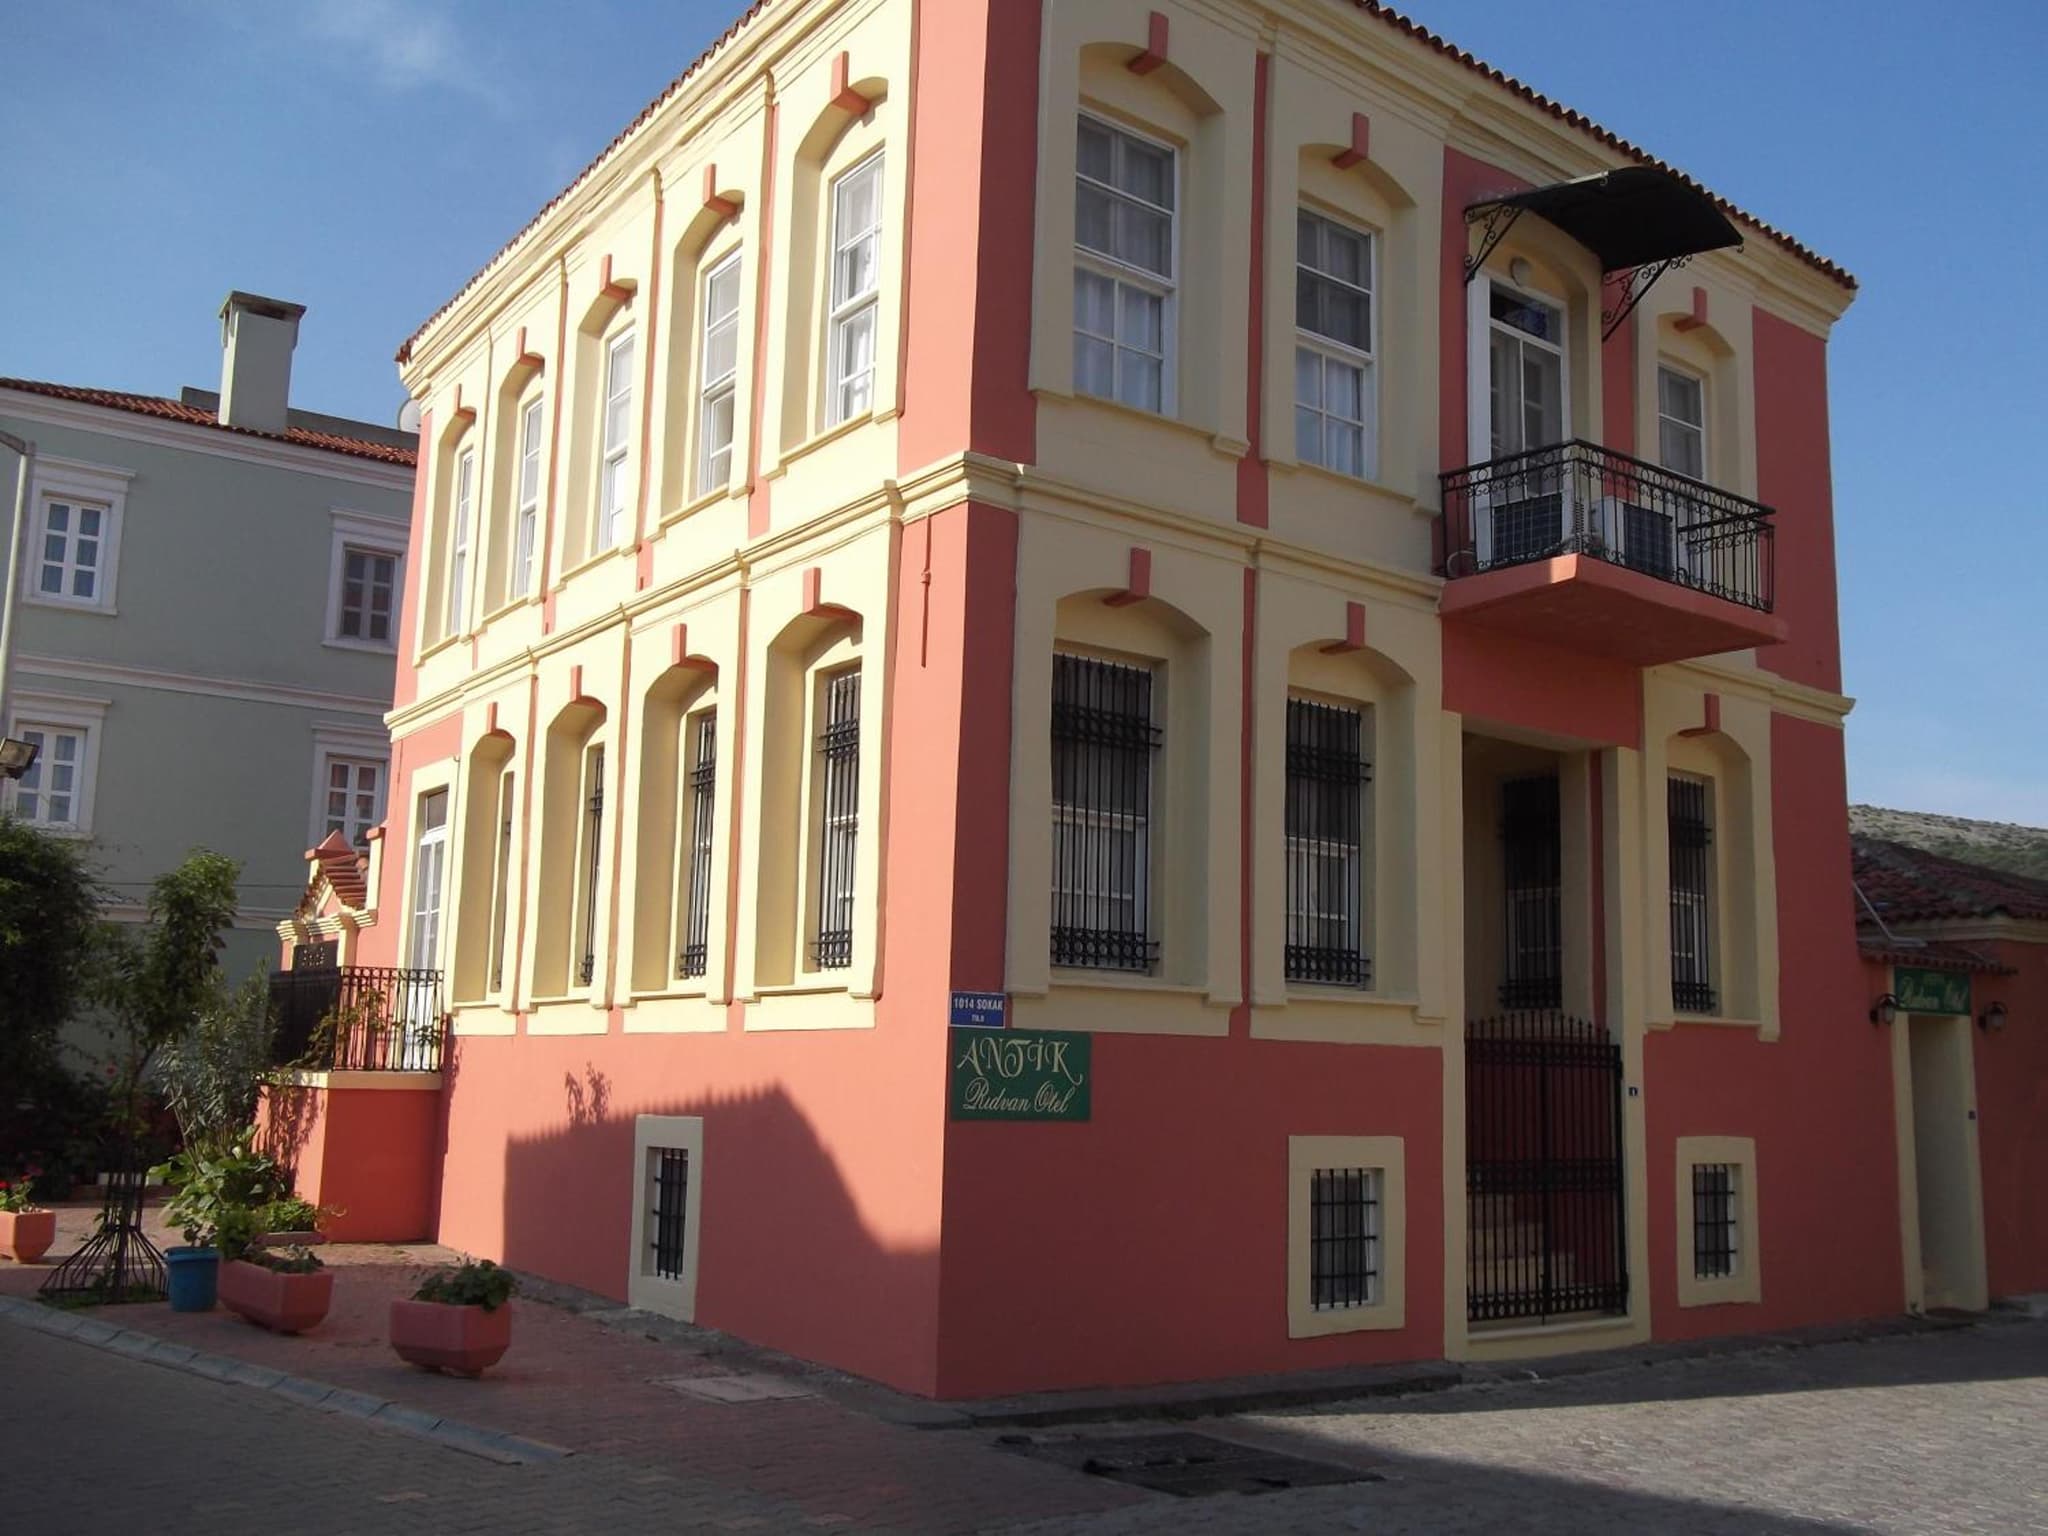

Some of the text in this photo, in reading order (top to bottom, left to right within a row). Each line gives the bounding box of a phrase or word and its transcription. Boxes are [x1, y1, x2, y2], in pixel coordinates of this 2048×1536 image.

[954, 997, 1003, 1010] 1014 SOKAK
[1034, 1080, 1076, 1112] Otel
